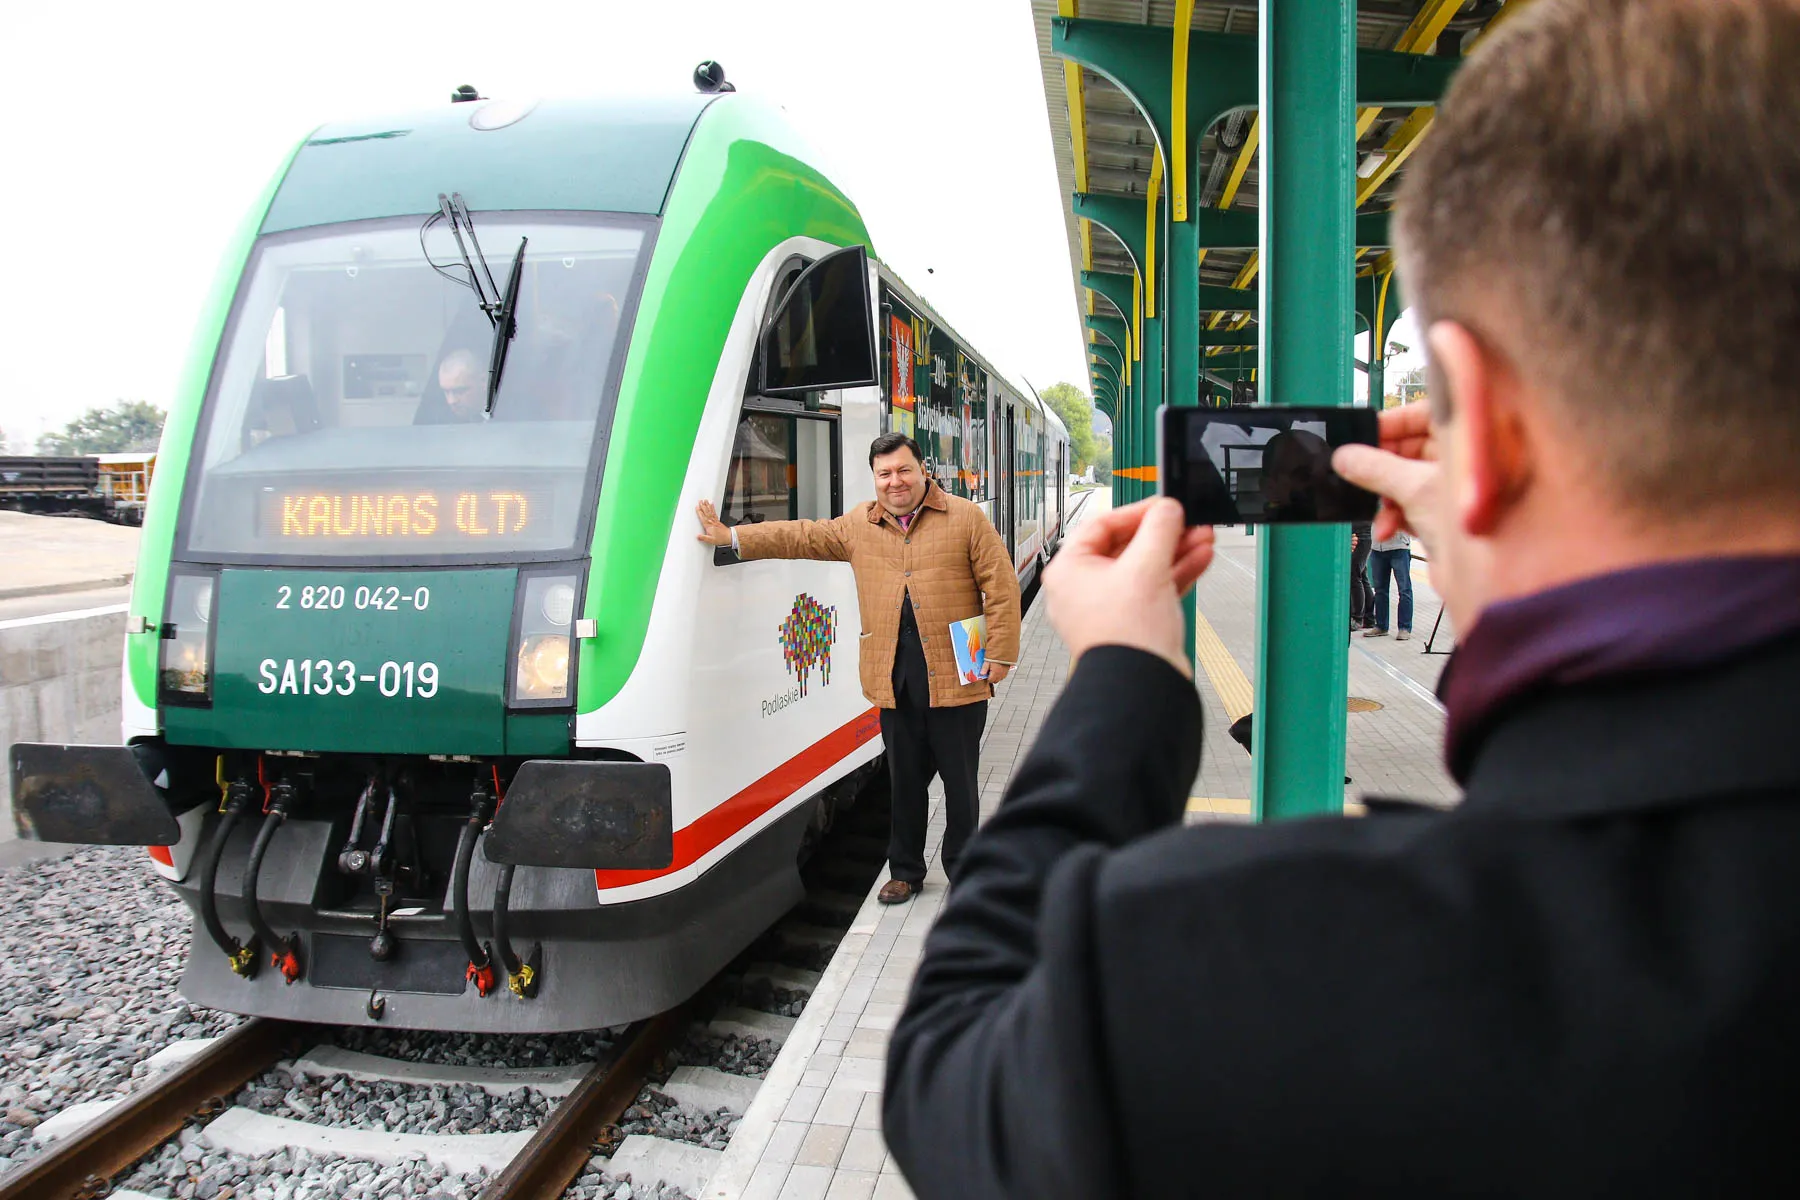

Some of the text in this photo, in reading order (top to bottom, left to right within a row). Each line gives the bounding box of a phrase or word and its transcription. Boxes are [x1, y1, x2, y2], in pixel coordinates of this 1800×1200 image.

[282, 494, 528, 536] KAUNAS (LT)
[276, 585, 430, 611] 2 820 042-0
[257, 658, 439, 699] SA133-019
[761, 687, 799, 719] Podlaskie
